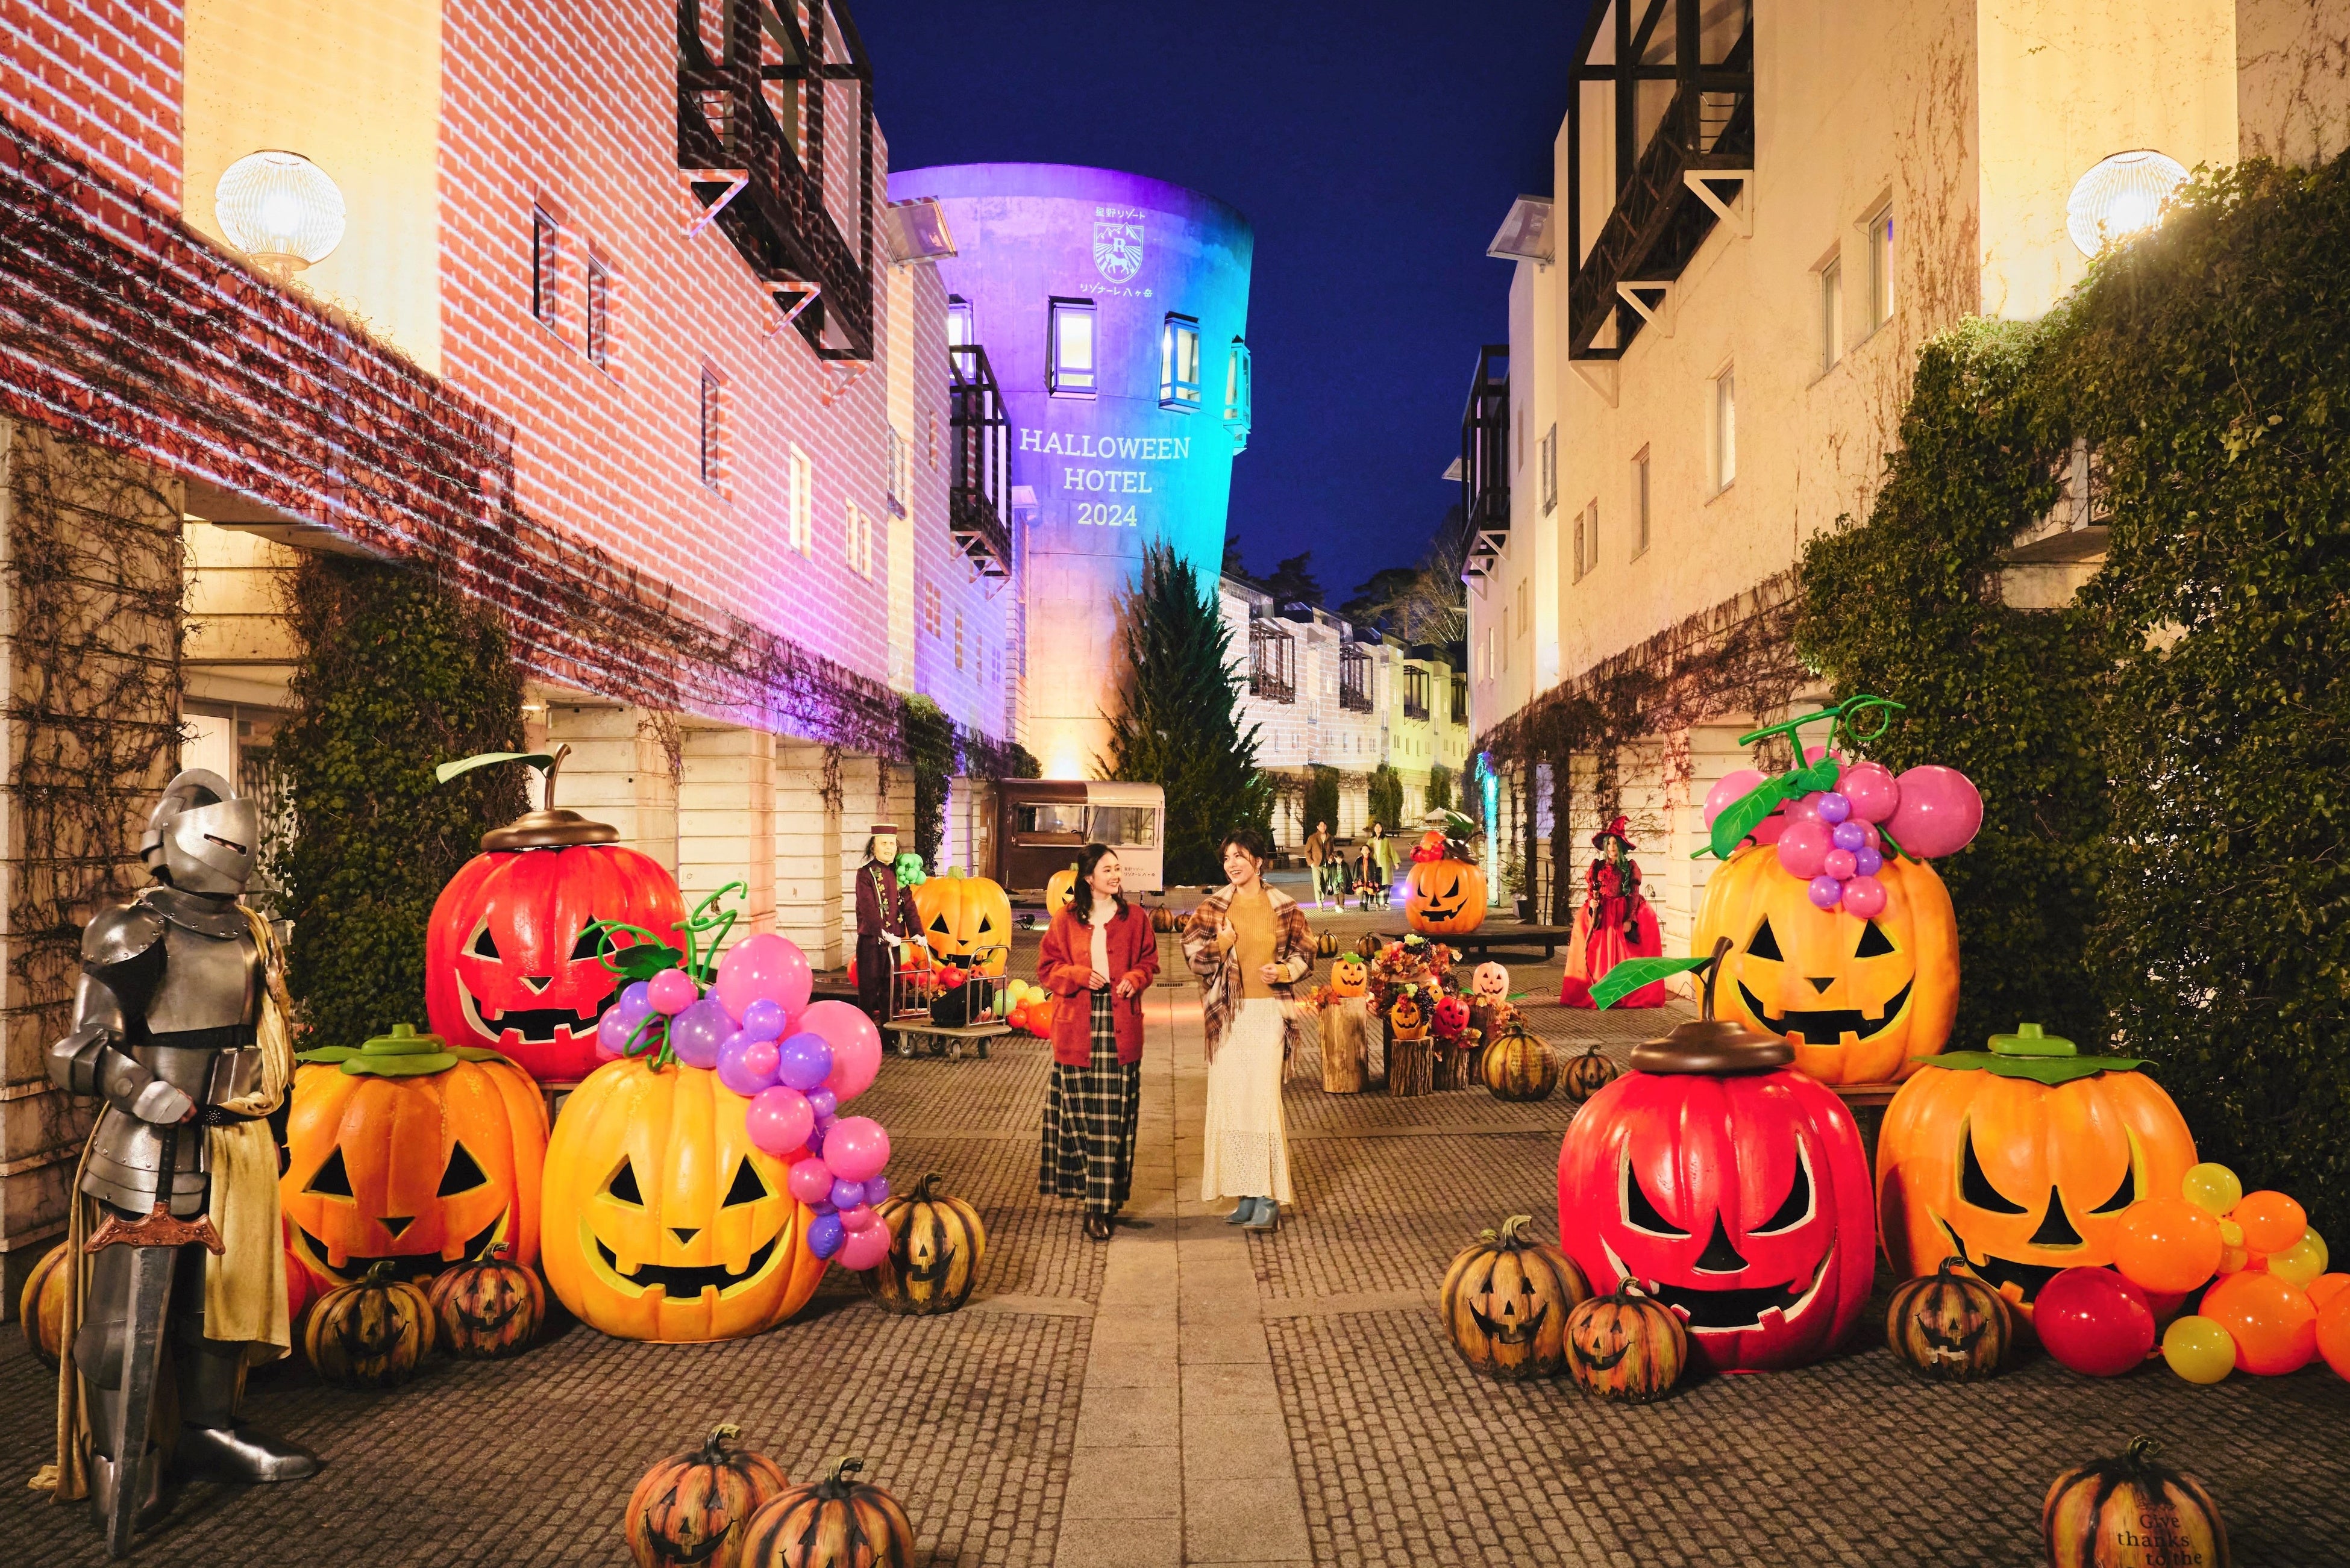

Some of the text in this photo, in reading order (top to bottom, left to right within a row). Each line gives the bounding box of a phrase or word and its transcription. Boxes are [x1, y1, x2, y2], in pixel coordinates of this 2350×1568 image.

[1095, 207, 1145, 220] 星野リゾート
[1113, 237, 1126, 252] R
[1020, 428, 1191, 460] HALLOWEEN
[1064, 467, 1152, 493] HOTEL
[1078, 503, 1138, 526] 2024
[2140, 1514, 2180, 1529] Give
[2117, 1531, 2190, 1547] thanks
[2146, 1551, 2202, 1566] to the
